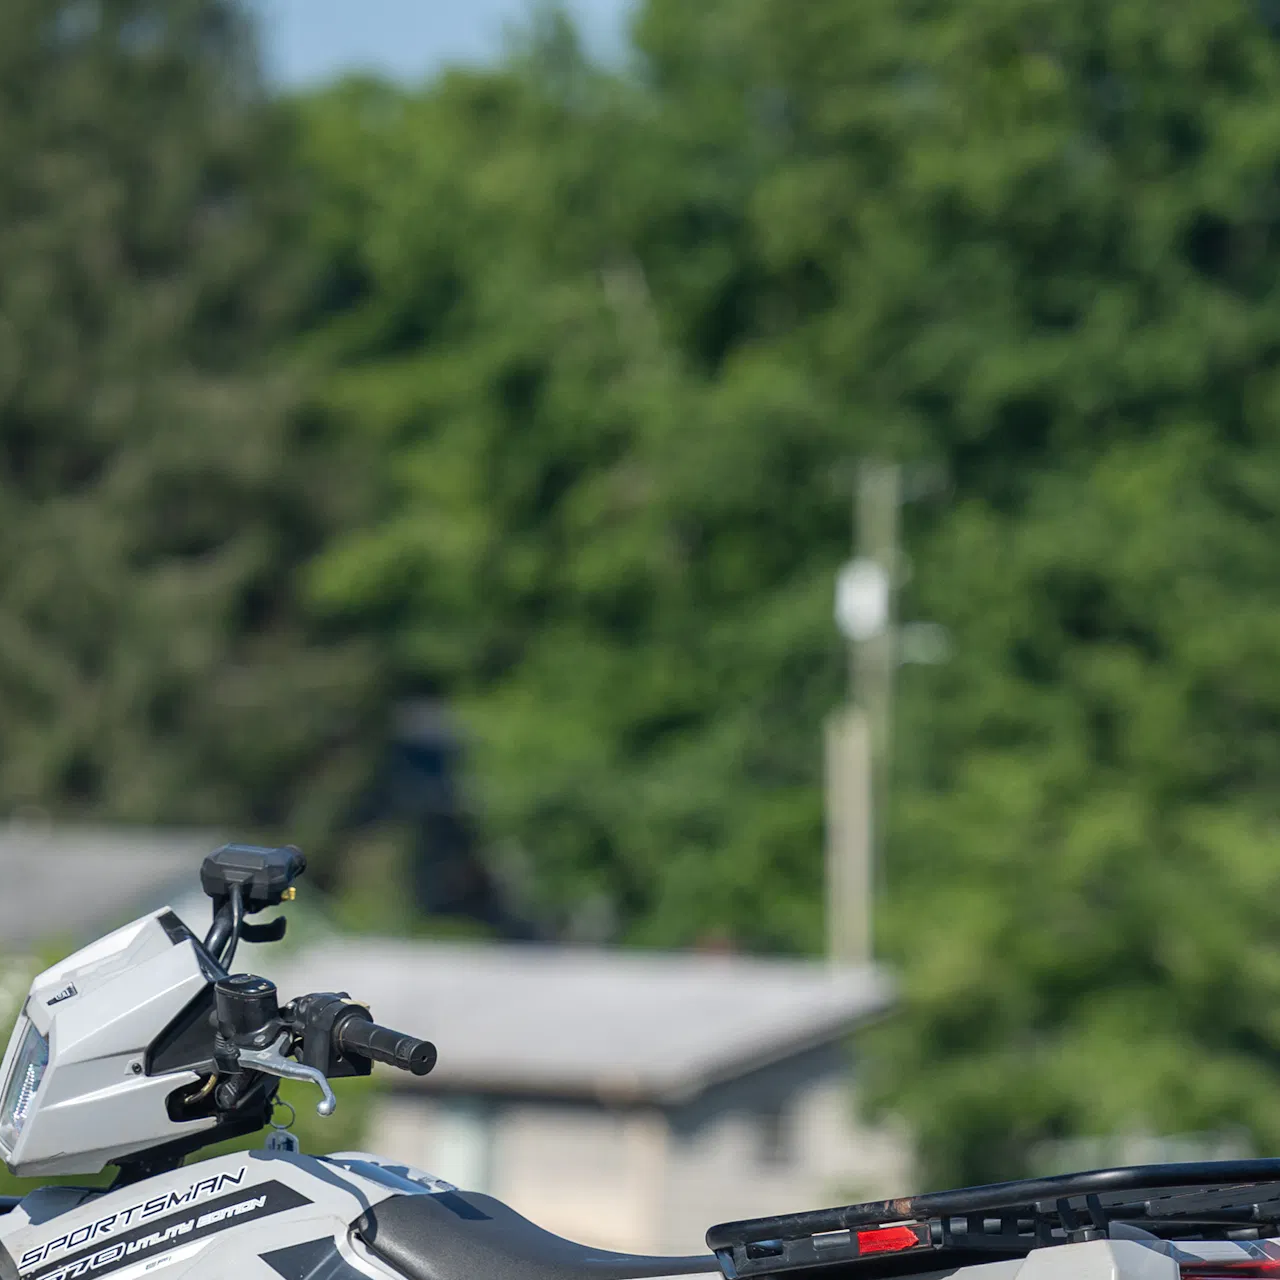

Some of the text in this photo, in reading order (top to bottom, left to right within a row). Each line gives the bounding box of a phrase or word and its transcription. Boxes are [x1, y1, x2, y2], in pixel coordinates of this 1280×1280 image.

[19, 1166, 248, 1270] SPORTSMAN
[126, 1218, 195, 1255] UTILITY
[195, 1196, 267, 1229] EDITION
